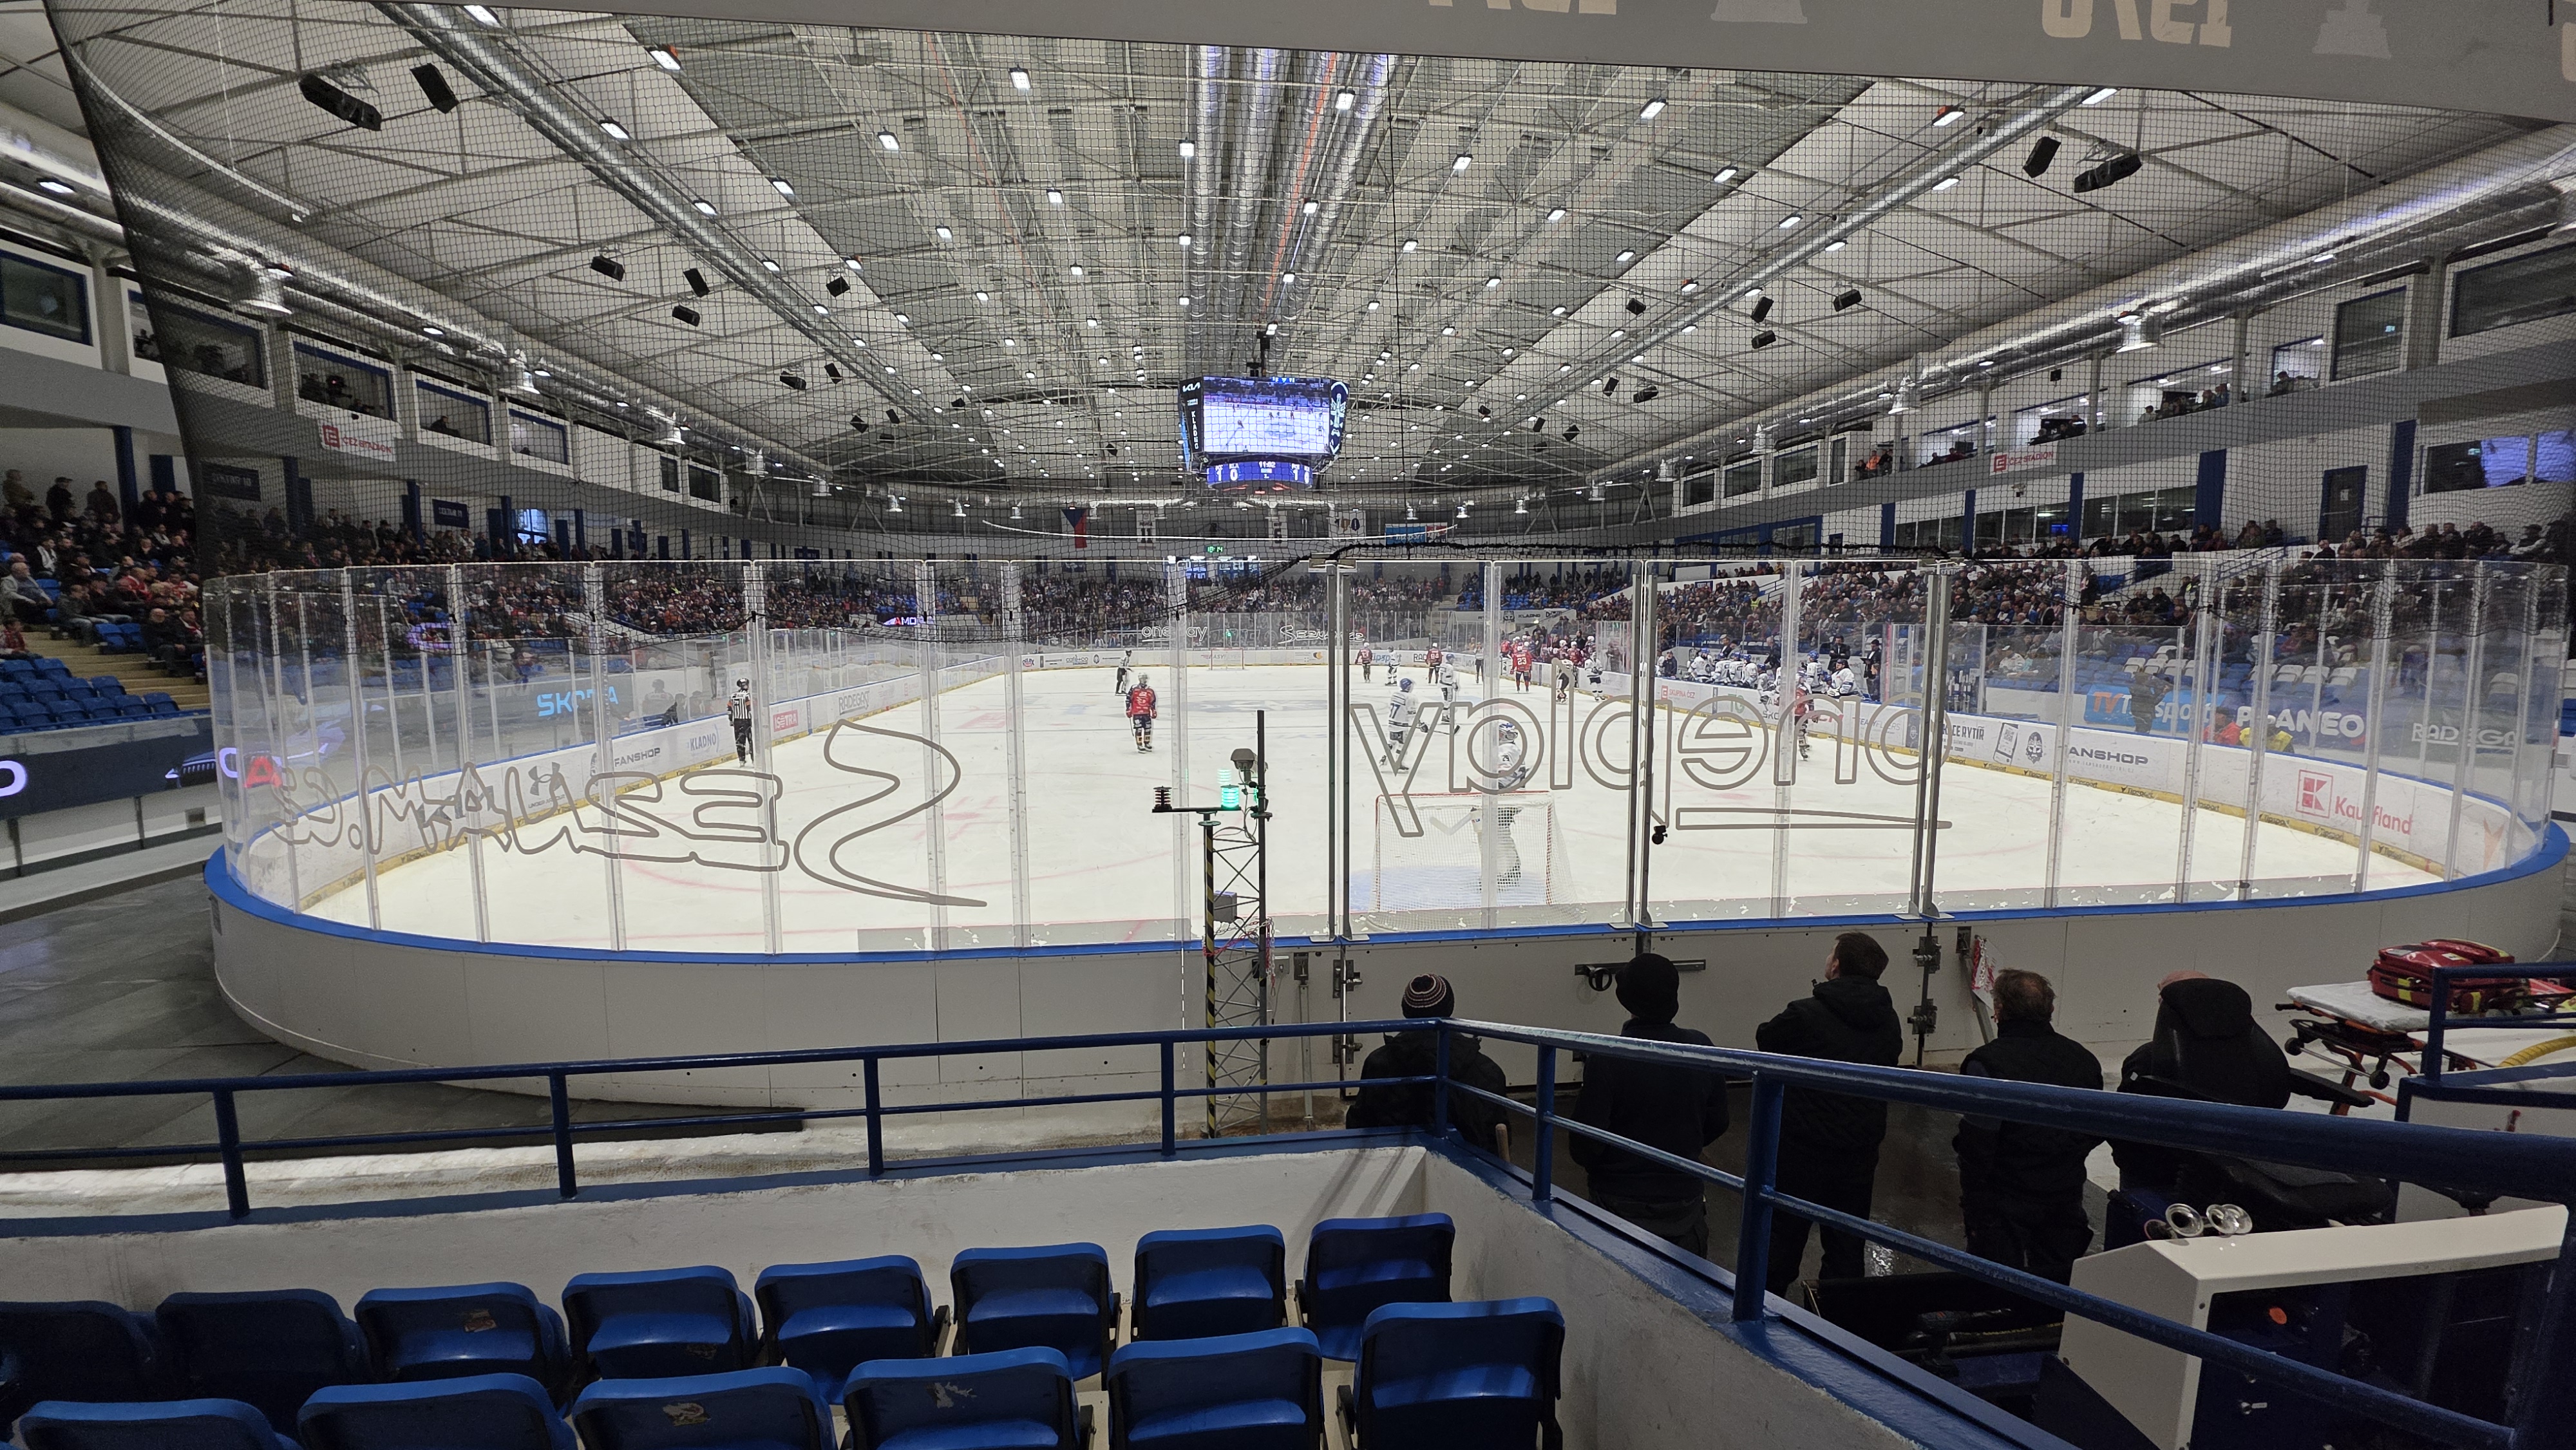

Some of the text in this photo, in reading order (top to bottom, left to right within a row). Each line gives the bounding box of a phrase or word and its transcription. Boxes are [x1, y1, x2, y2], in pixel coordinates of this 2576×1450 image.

[2237, 706, 2364, 738] PANEO
[690, 733, 717, 751] KLADNO
[614, 747, 661, 767] FANSHOP
[2069, 746, 2149, 766] ANSHOP
